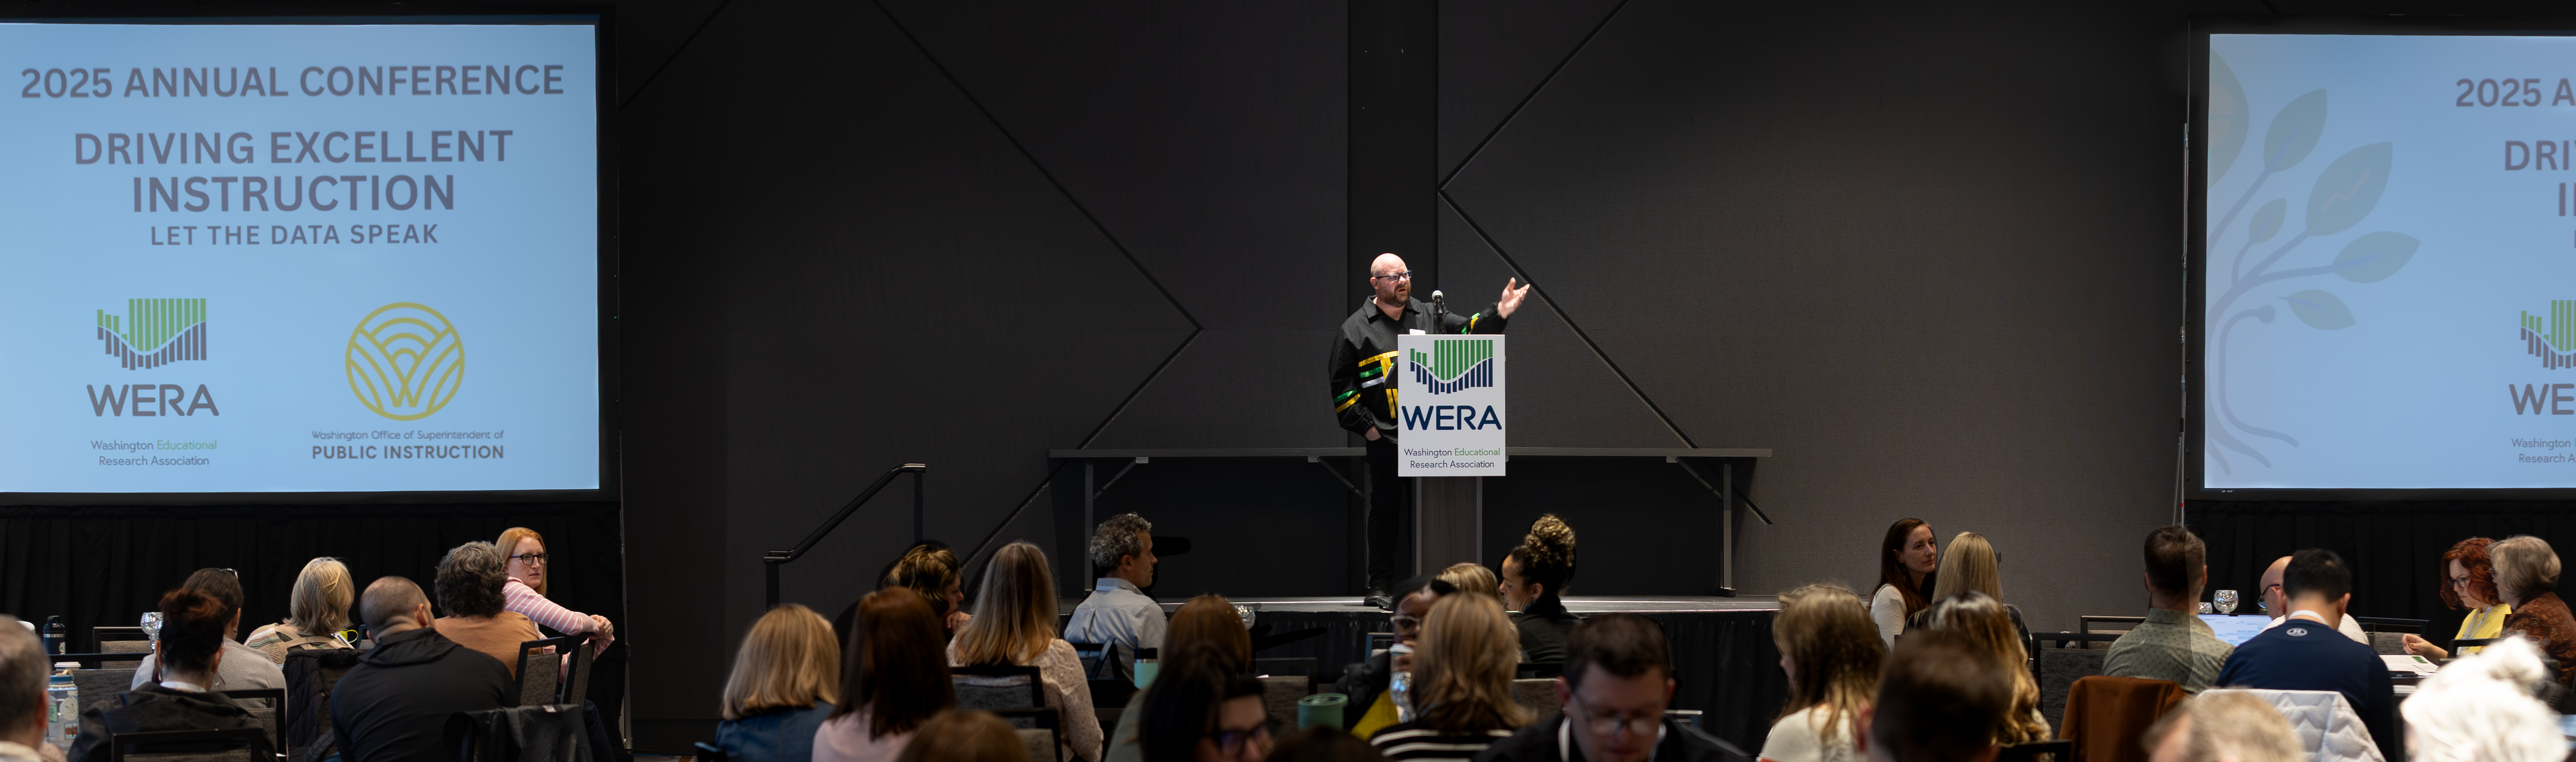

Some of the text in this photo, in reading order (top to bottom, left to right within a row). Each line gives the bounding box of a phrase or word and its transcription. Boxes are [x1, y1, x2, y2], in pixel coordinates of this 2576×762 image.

[21, 64, 564, 99] 2025 ANNUAL CONFERENCE
[2455, 77, 2542, 108] 2025
[75, 129, 514, 165] DRIVING EXCELLENT
[2504, 139, 2576, 171] DRI
[133, 174, 454, 213] INSTRUCTION
[151, 223, 439, 246] LET THE DATA SPEAK
[86, 383, 220, 417] WERA
[2508, 383, 2576, 416] WE
[1401, 404, 1503, 431] WERA
[90, 439, 217, 453] Washington Educational
[311, 430, 504, 442] Washington Office of Superintendent of
[2511, 437, 2571, 450] Washington
[99, 455, 210, 466] Research Association
[312, 444, 504, 460] PUBLIC INSTRUCTION
[1404, 447, 1500, 458] Washington Educational
[2519, 453, 2576, 463] Research A
[1410, 460, 1494, 468] Research Association
